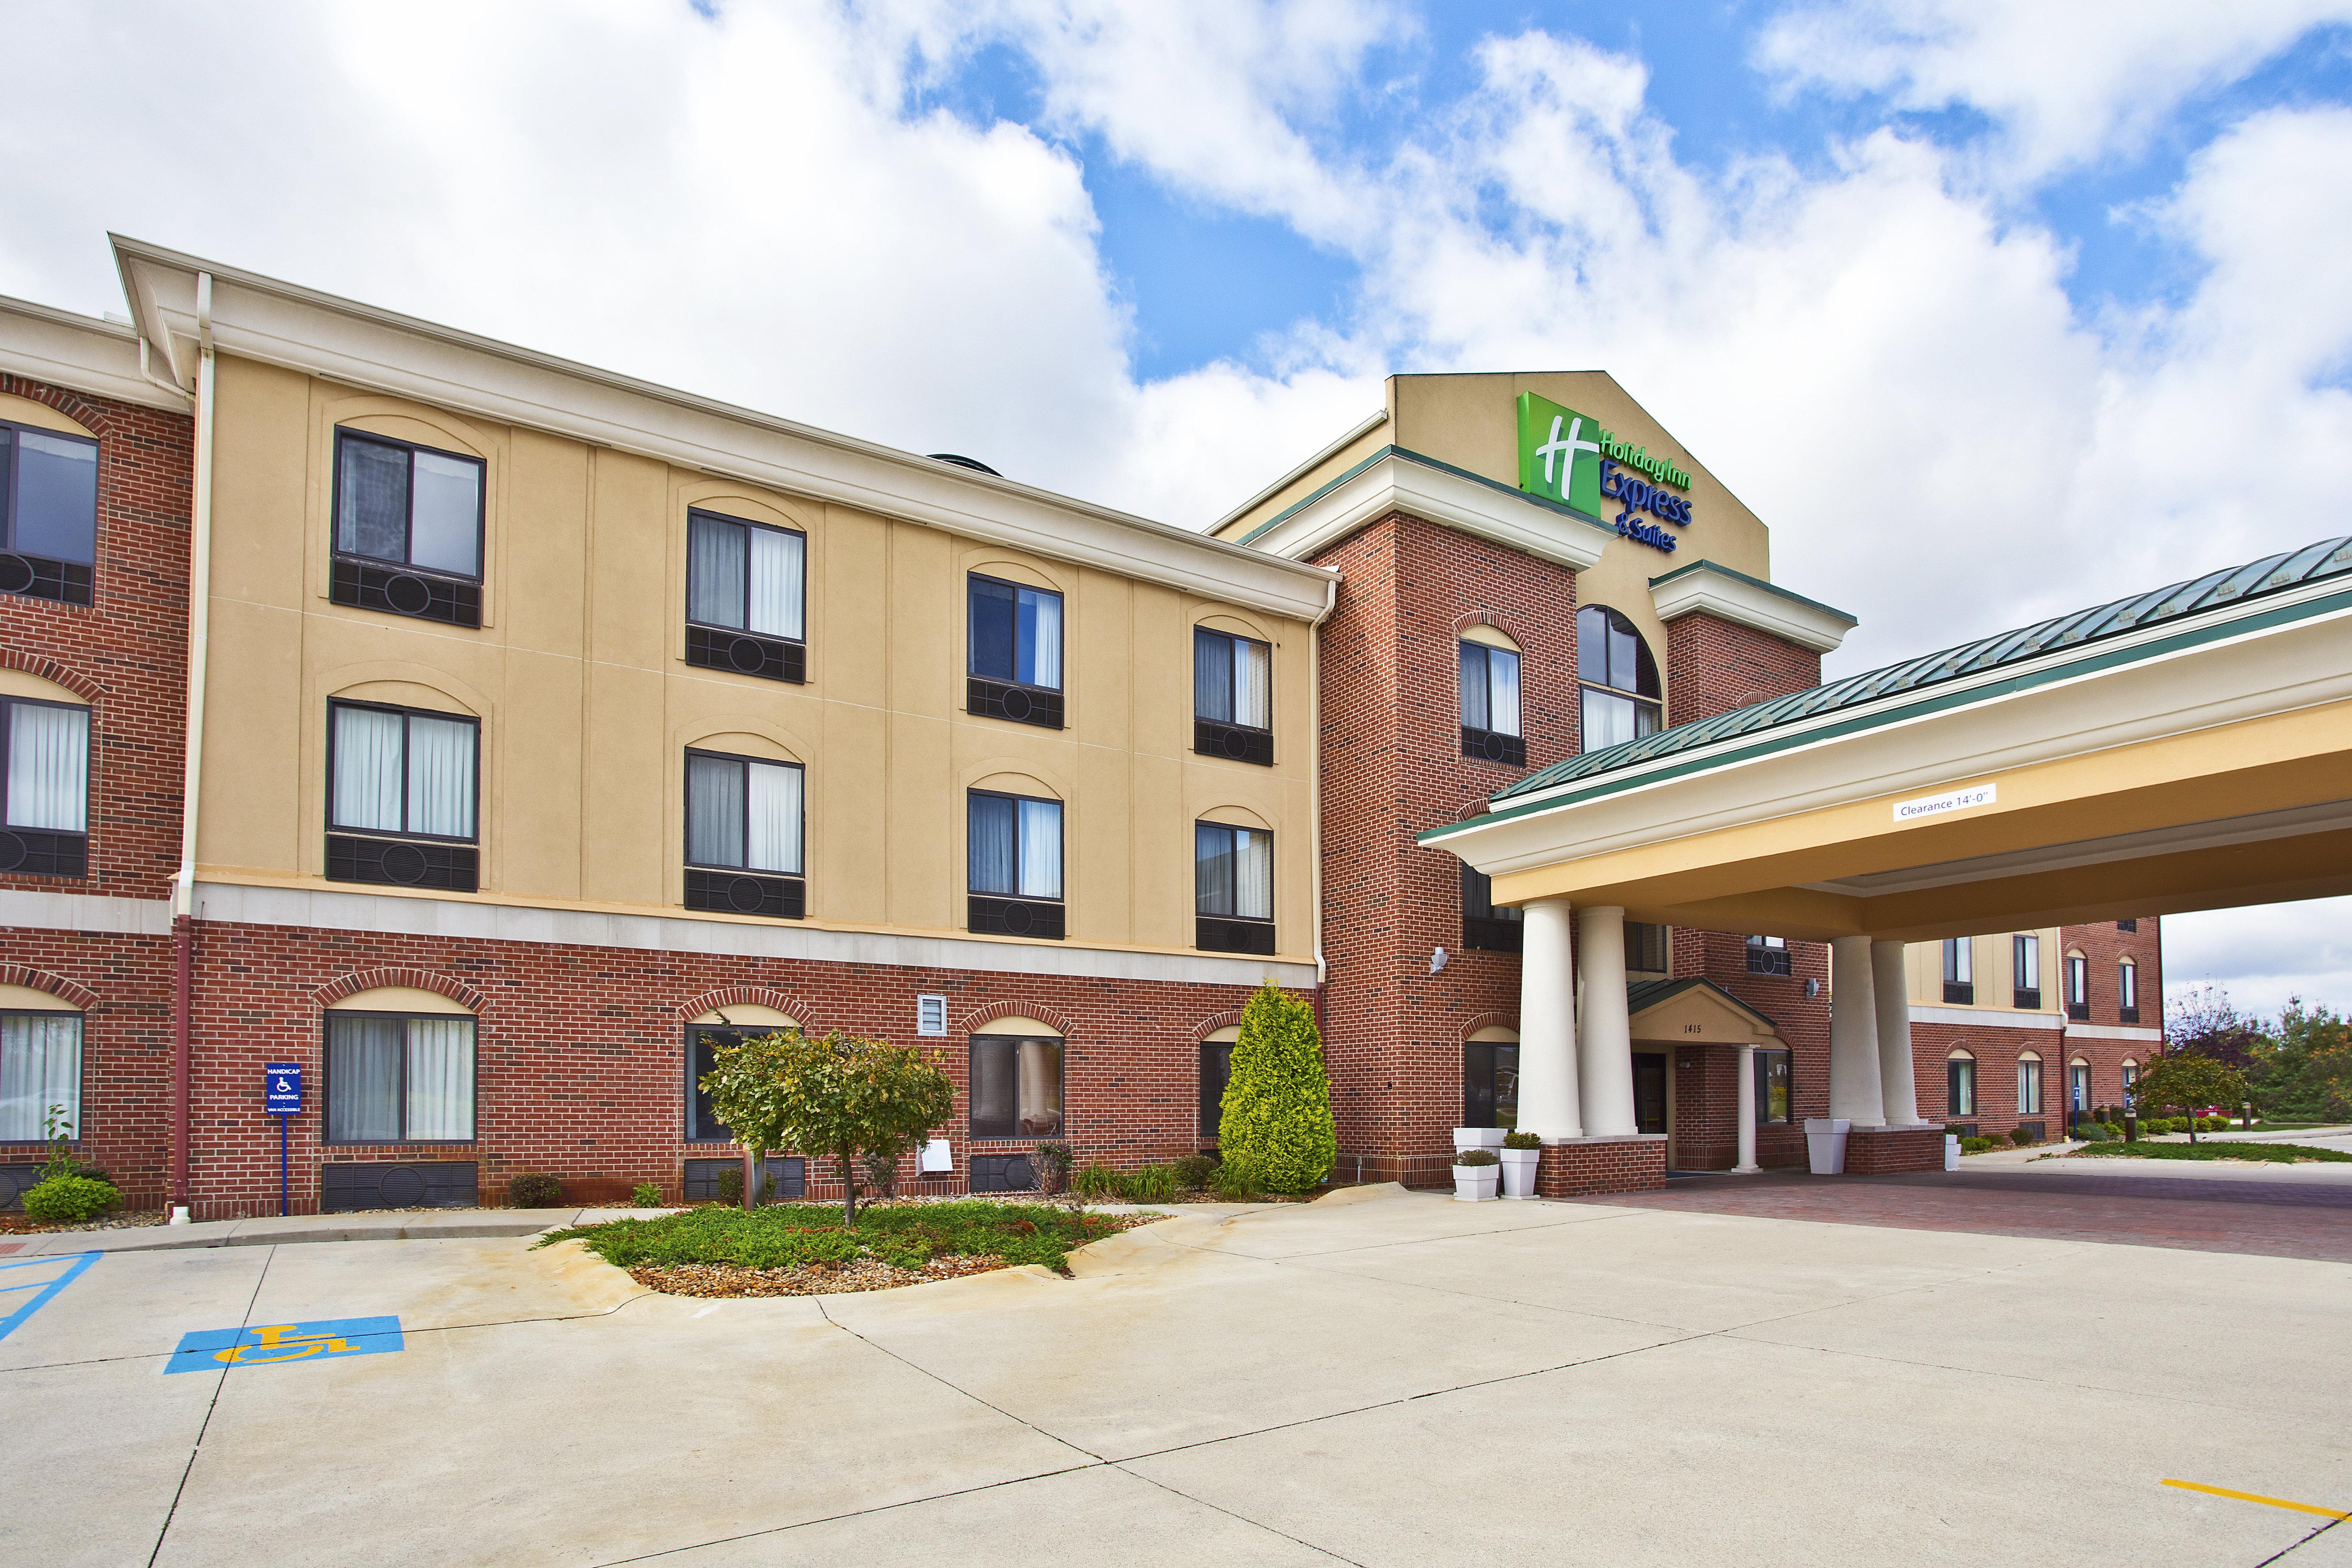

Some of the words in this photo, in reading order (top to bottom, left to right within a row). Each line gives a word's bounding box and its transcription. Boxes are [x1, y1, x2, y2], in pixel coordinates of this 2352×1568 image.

[1536, 415, 1599, 500] H
[1600, 429, 1665, 484] Holiday
[1667, 458, 1692, 491] Inn
[1600, 459, 1693, 527] Express
[1615, 512, 1630, 536] &
[1628, 517, 1677, 553] Suites
[1901, 800, 1952, 816] Clearance
[1684, 1024, 1701, 1033] 1415
